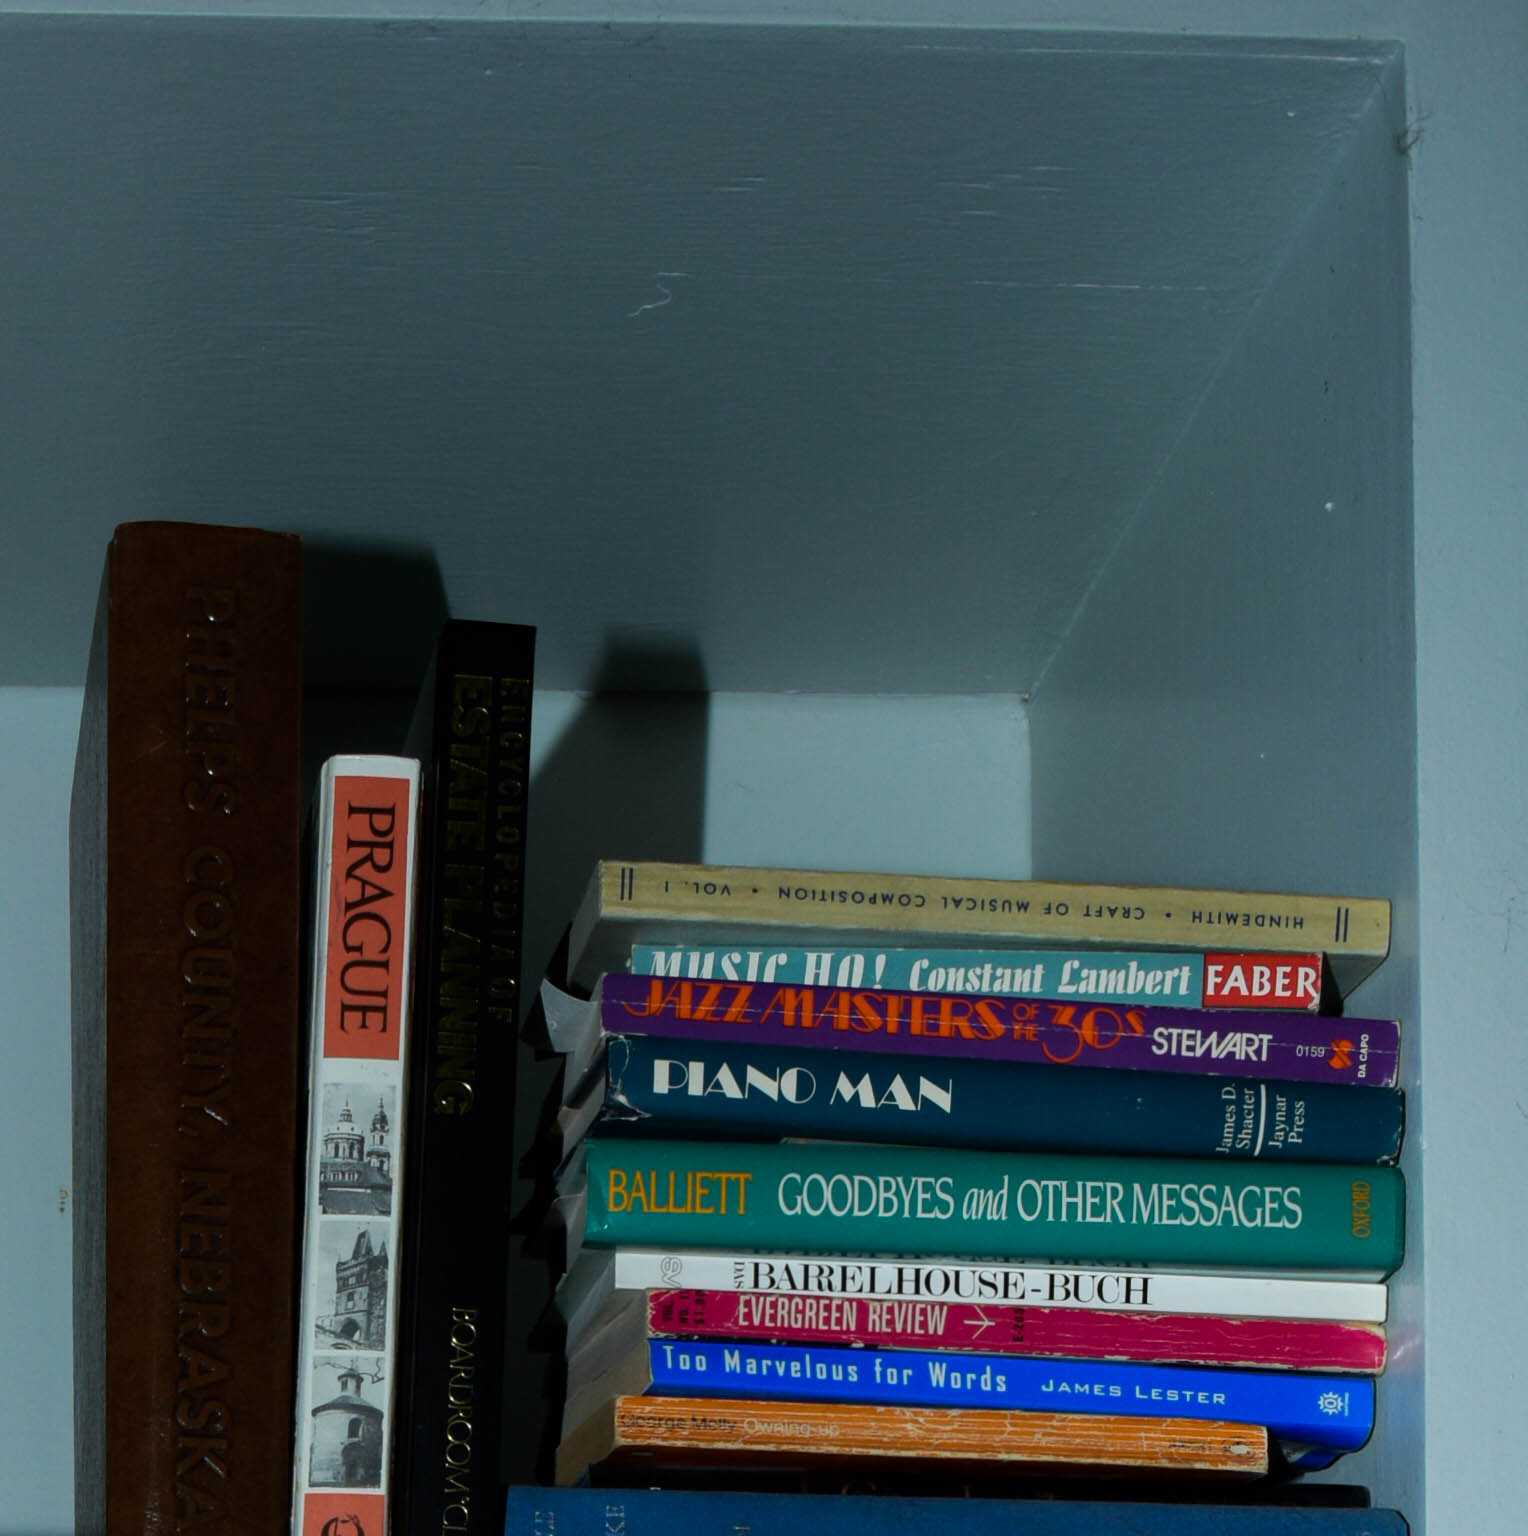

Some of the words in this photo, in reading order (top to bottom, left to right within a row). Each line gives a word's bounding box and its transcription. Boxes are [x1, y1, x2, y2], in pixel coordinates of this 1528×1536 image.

[779, 887, 925, 907] COMPOSITION
[943, 894, 1029, 912] MUSICAL
[1044, 902, 1069, 917] OF
[1084, 904, 1144, 921] CRAFT
[340, 803, 394, 1031] PRAGUE
[1192, 910, 1303, 931] HINDEMITH
[909, 957, 1043, 994] Constant
[1057, 959, 1191, 997] Lambert
[1205, 964, 1320, 998] FABER
[1151, 1027, 1273, 1063] STEWART
[1296, 1044, 1325, 1059] 0159
[653, 1057, 817, 1104] PIANO
[829, 1069, 953, 1115] MAN
[607, 1168, 753, 1215] BALLIETT
[776, 1172, 956, 1220] GOODBYES
[962, 1175, 1009, 1221] and
[1016, 1178, 1130, 1224] OTHER
[1131, 1182, 1303, 1229] MESSAGES
[737, 1295, 857, 1332] EVERGREEN
[867, 1301, 947, 1336] REVIEW
